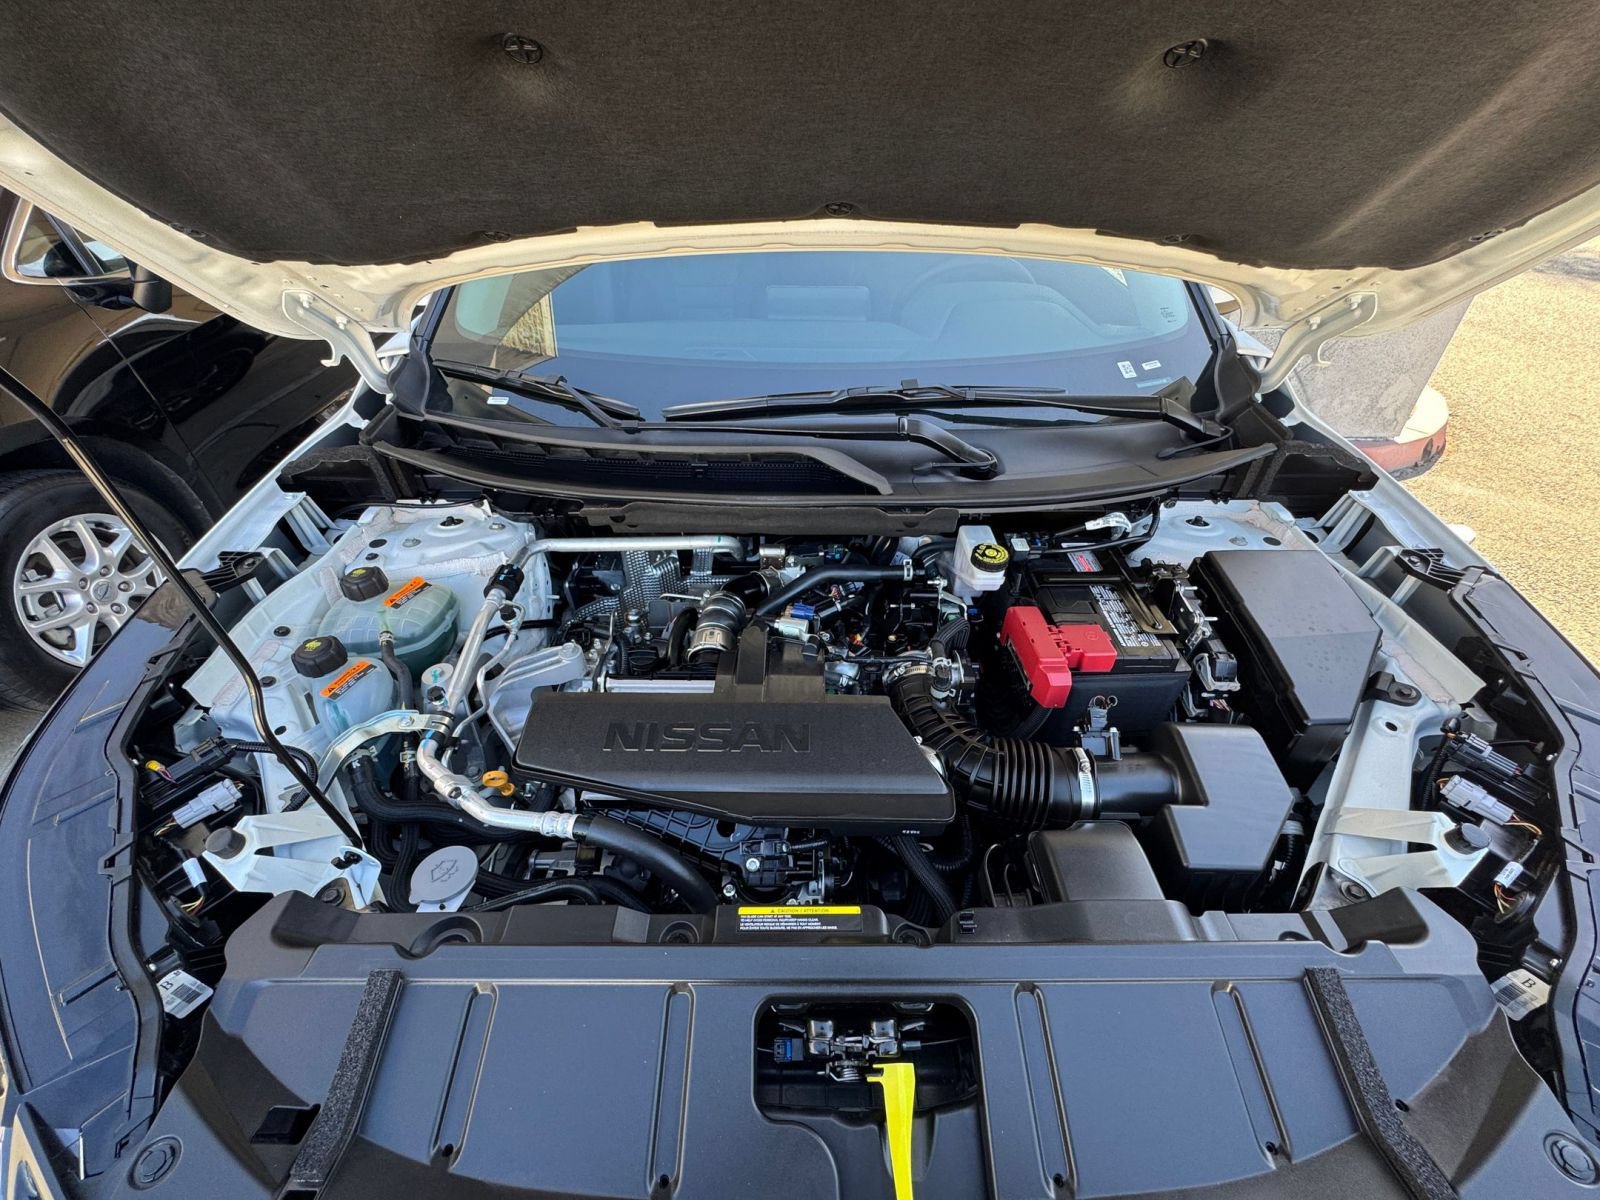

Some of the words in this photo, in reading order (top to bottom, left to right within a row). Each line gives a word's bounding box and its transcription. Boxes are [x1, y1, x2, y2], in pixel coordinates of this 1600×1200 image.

[603, 720, 811, 752] NISSAN
[160, 980, 174, 991] B
[1521, 978, 1536, 988] B
